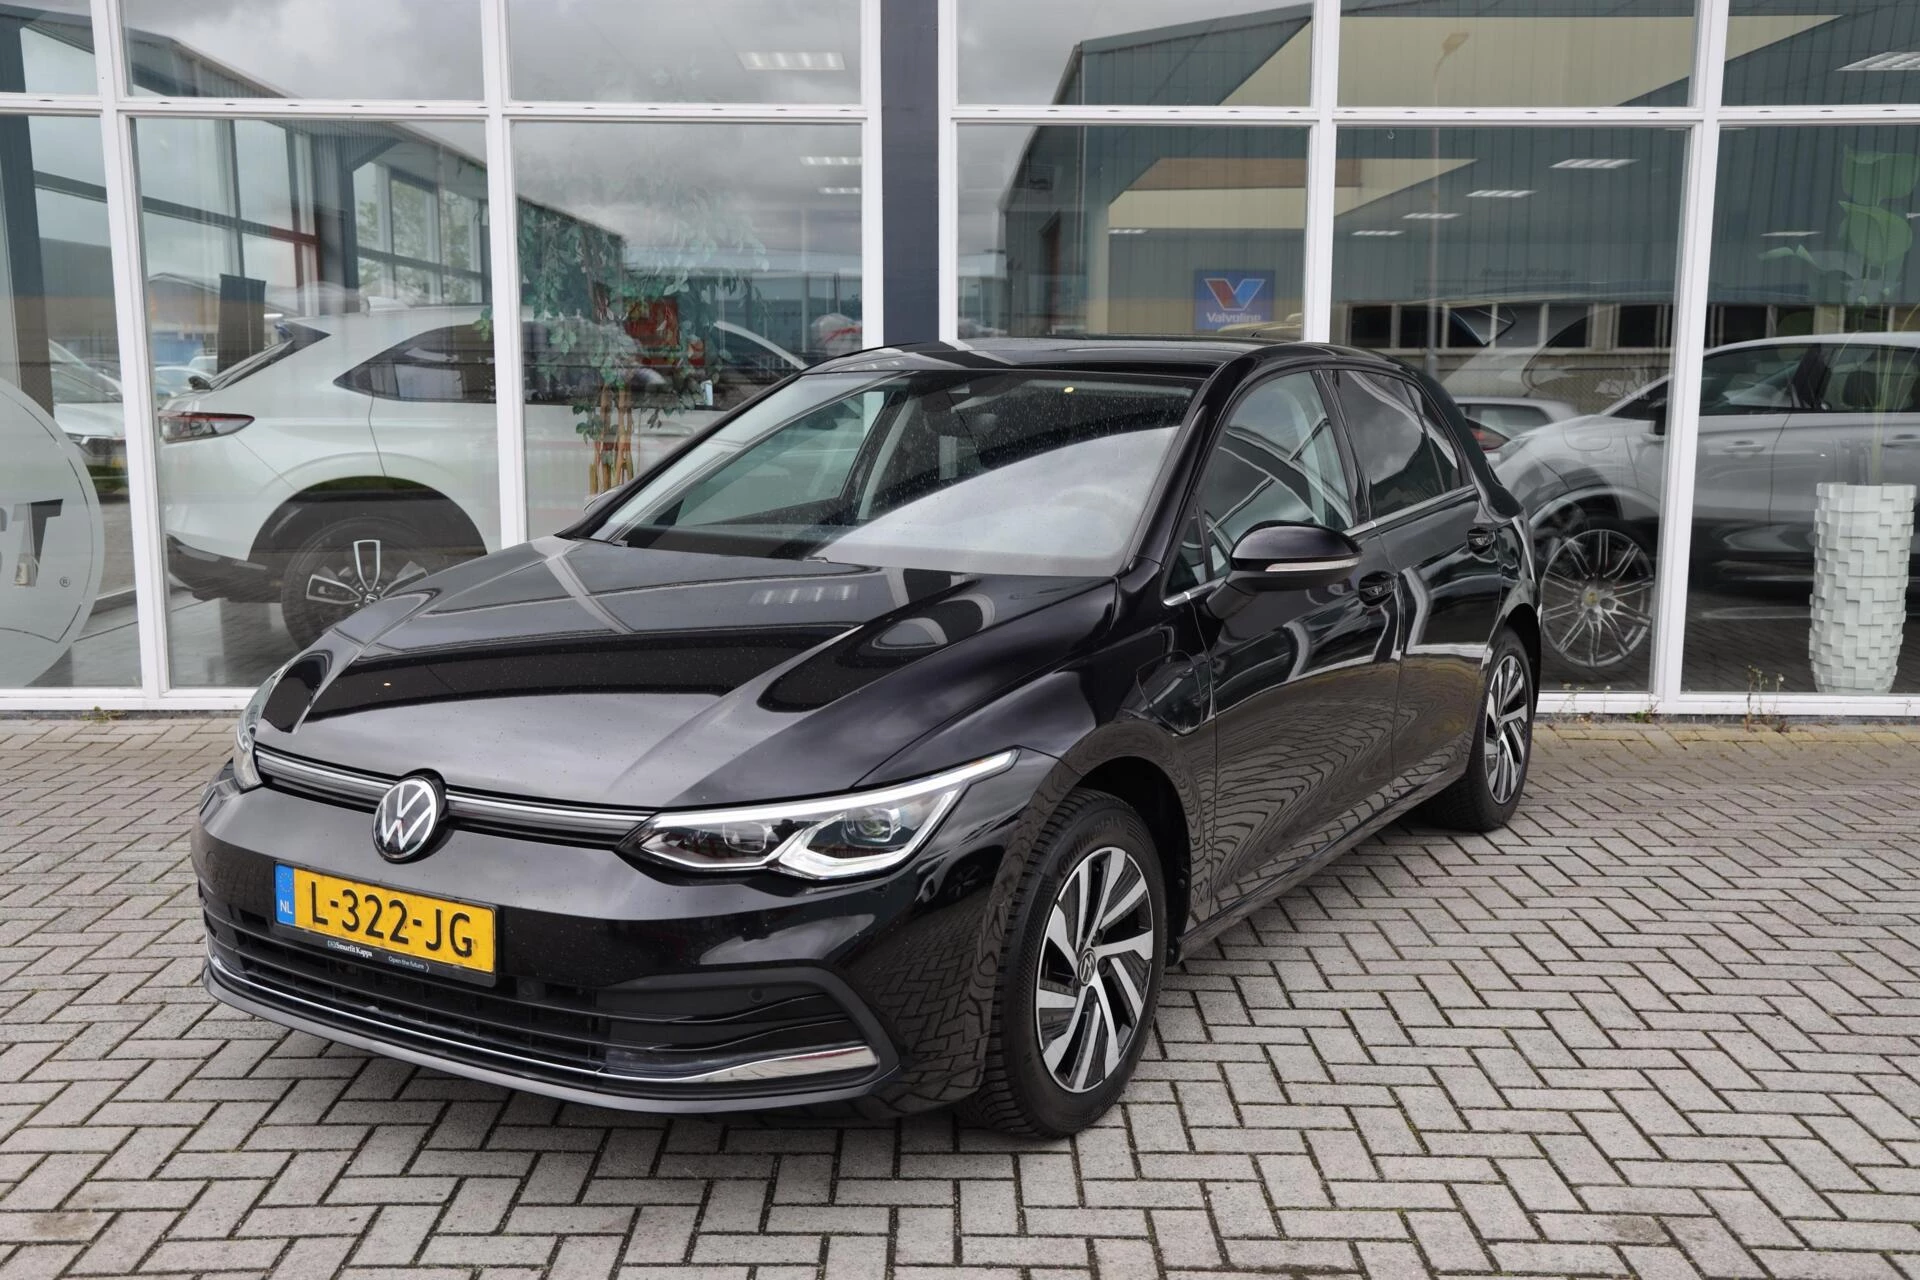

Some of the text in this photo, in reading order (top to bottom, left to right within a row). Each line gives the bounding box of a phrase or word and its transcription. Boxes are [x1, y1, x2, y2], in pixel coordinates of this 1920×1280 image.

[1206, 312, 1262, 323] Valvoline
[280, 899, 293, 915] NL
[311, 881, 473, 958] L-322-JG
